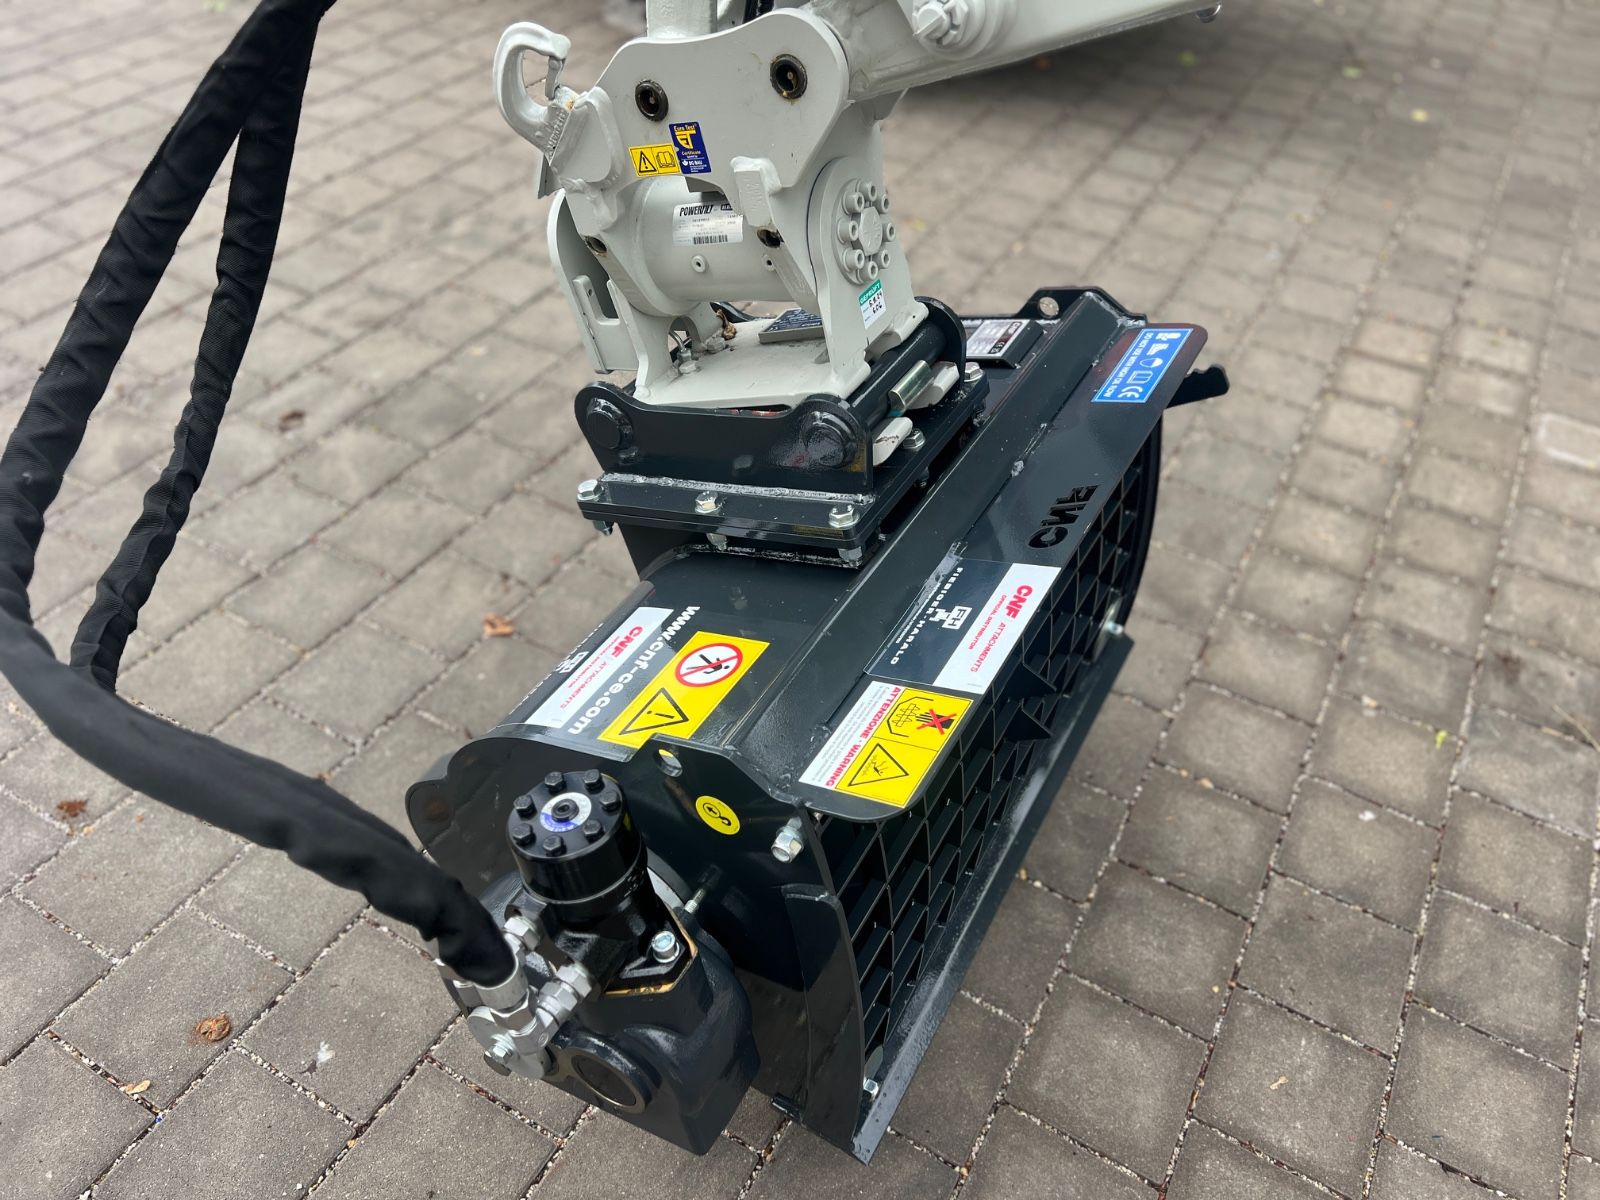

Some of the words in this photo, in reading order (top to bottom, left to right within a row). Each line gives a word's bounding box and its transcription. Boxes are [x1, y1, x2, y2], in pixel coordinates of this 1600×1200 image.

[1005, 585, 1033, 619] CNF
[612, 626, 643, 657] CNF
[968, 616, 993, 650] DISTRIBUTOR
[970, 622, 1006, 672] ATTACHMENTS
[560, 661, 607, 709] ATTACHMENTS
[567, 606, 701, 734] www.cnf-ce.com
[859, 687, 902, 738] ATTENZIONE
[825, 743, 862, 787] WARNING
